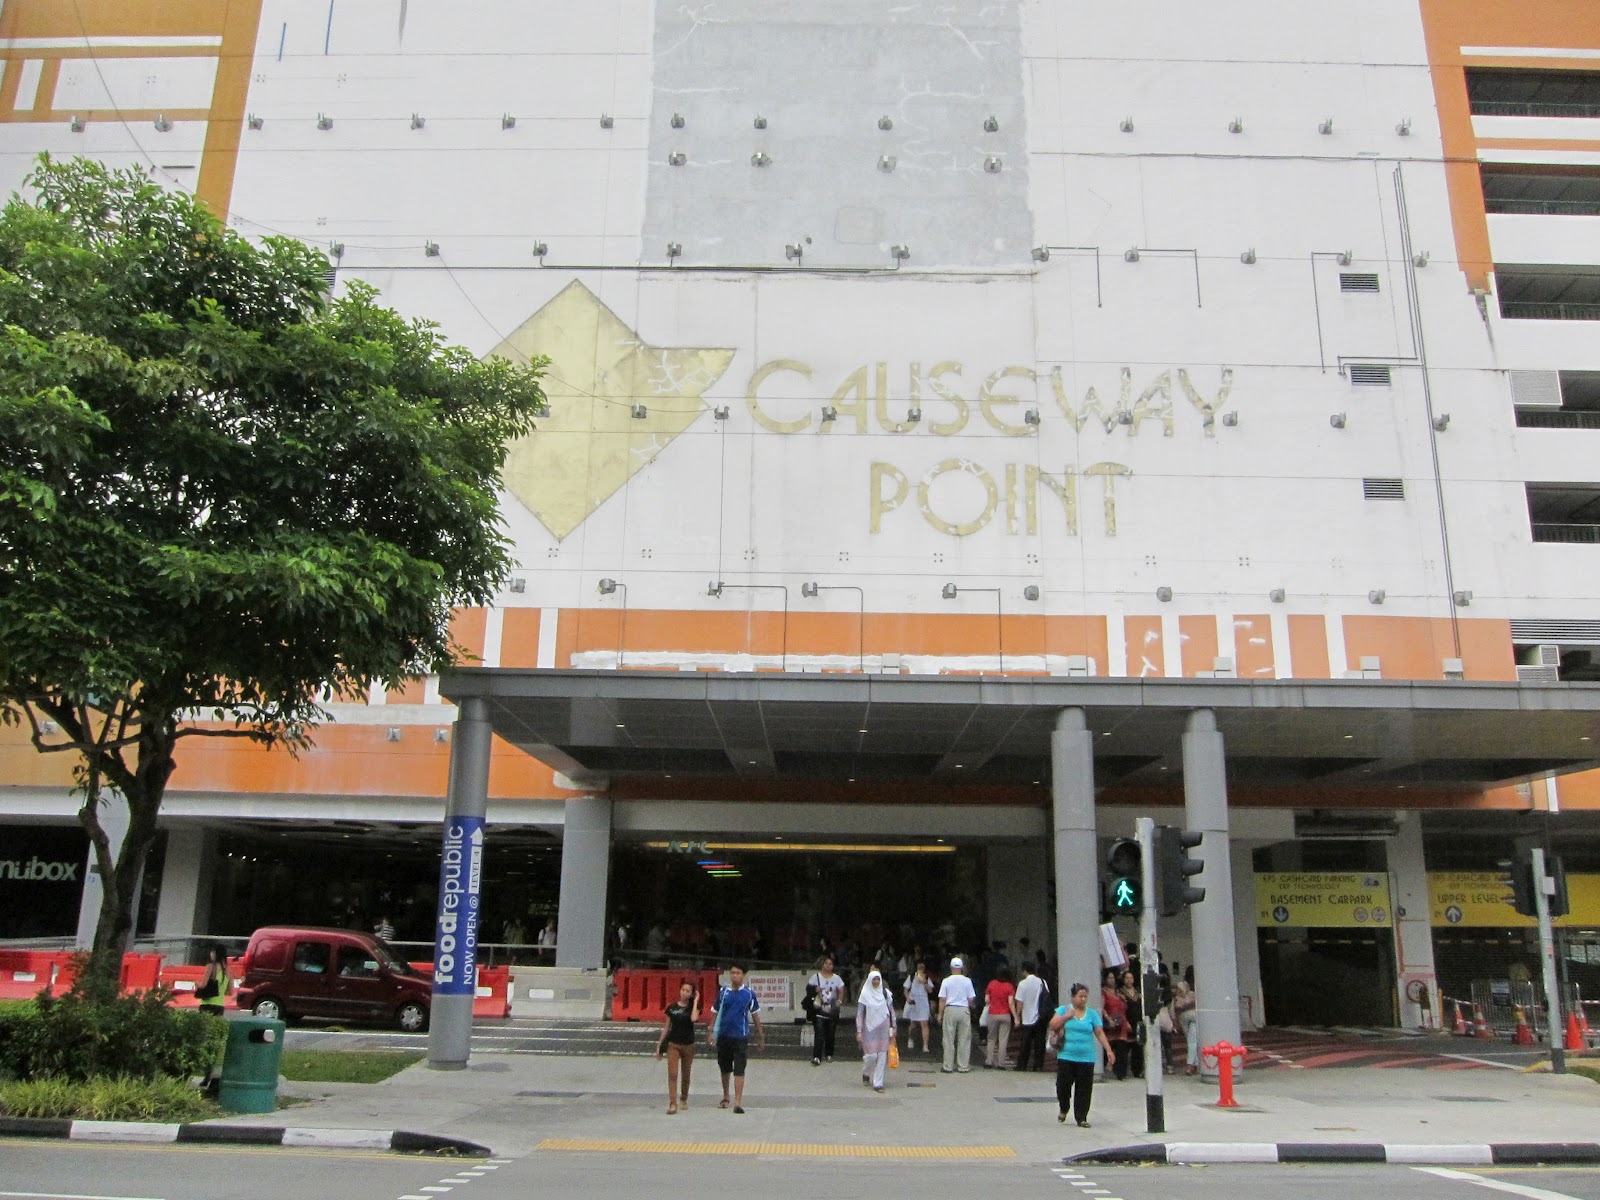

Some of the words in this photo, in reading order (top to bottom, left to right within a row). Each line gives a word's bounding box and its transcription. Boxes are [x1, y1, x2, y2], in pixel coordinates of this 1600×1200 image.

[746, 359, 1234, 437] CAUSEWAY
[869, 457, 1135, 537] POINT
[471, 862, 480, 889] LEVEL
[435, 825, 465, 985] foodrepublic
[1270, 894, 1322, 905] BASEMENT
[1328, 894, 1374, 905] CARPARK
[1437, 893, 1466, 904] UPPER
[1471, 893, 1500, 904] LEVEL
[465, 911, 477, 948] OPEN
[464, 950, 474, 985] NOW
